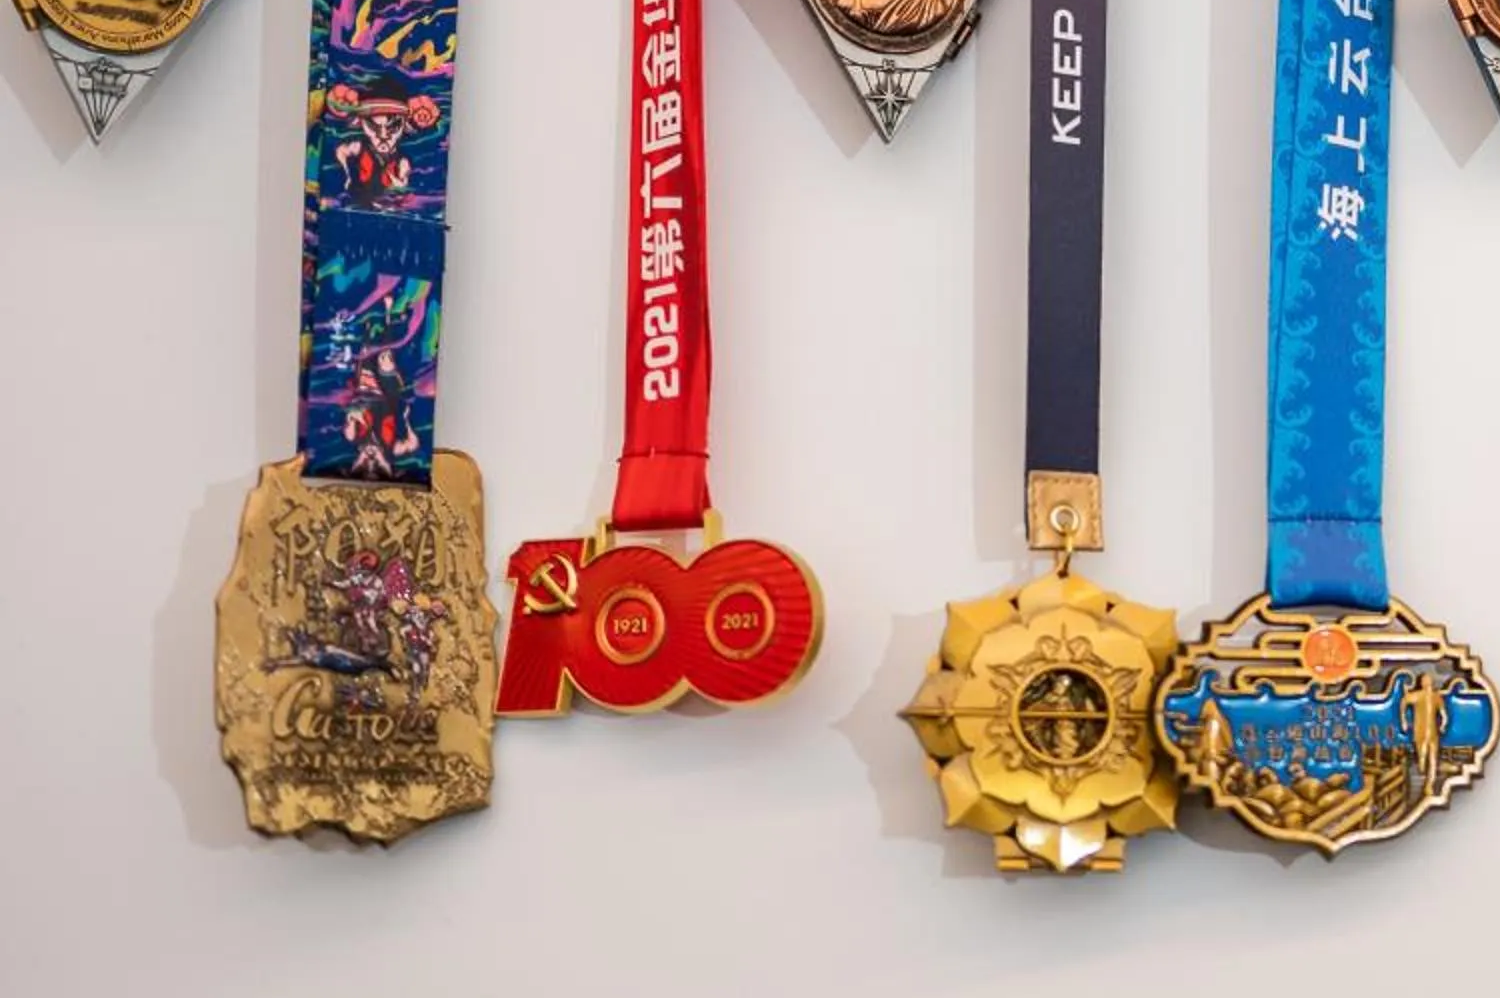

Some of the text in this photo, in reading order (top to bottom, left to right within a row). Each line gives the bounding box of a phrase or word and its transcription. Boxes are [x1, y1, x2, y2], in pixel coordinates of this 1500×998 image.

[1050, 8, 1085, 148] KEEP
[612, 617, 648, 635] 1921
[721, 613, 759, 631] 2021
